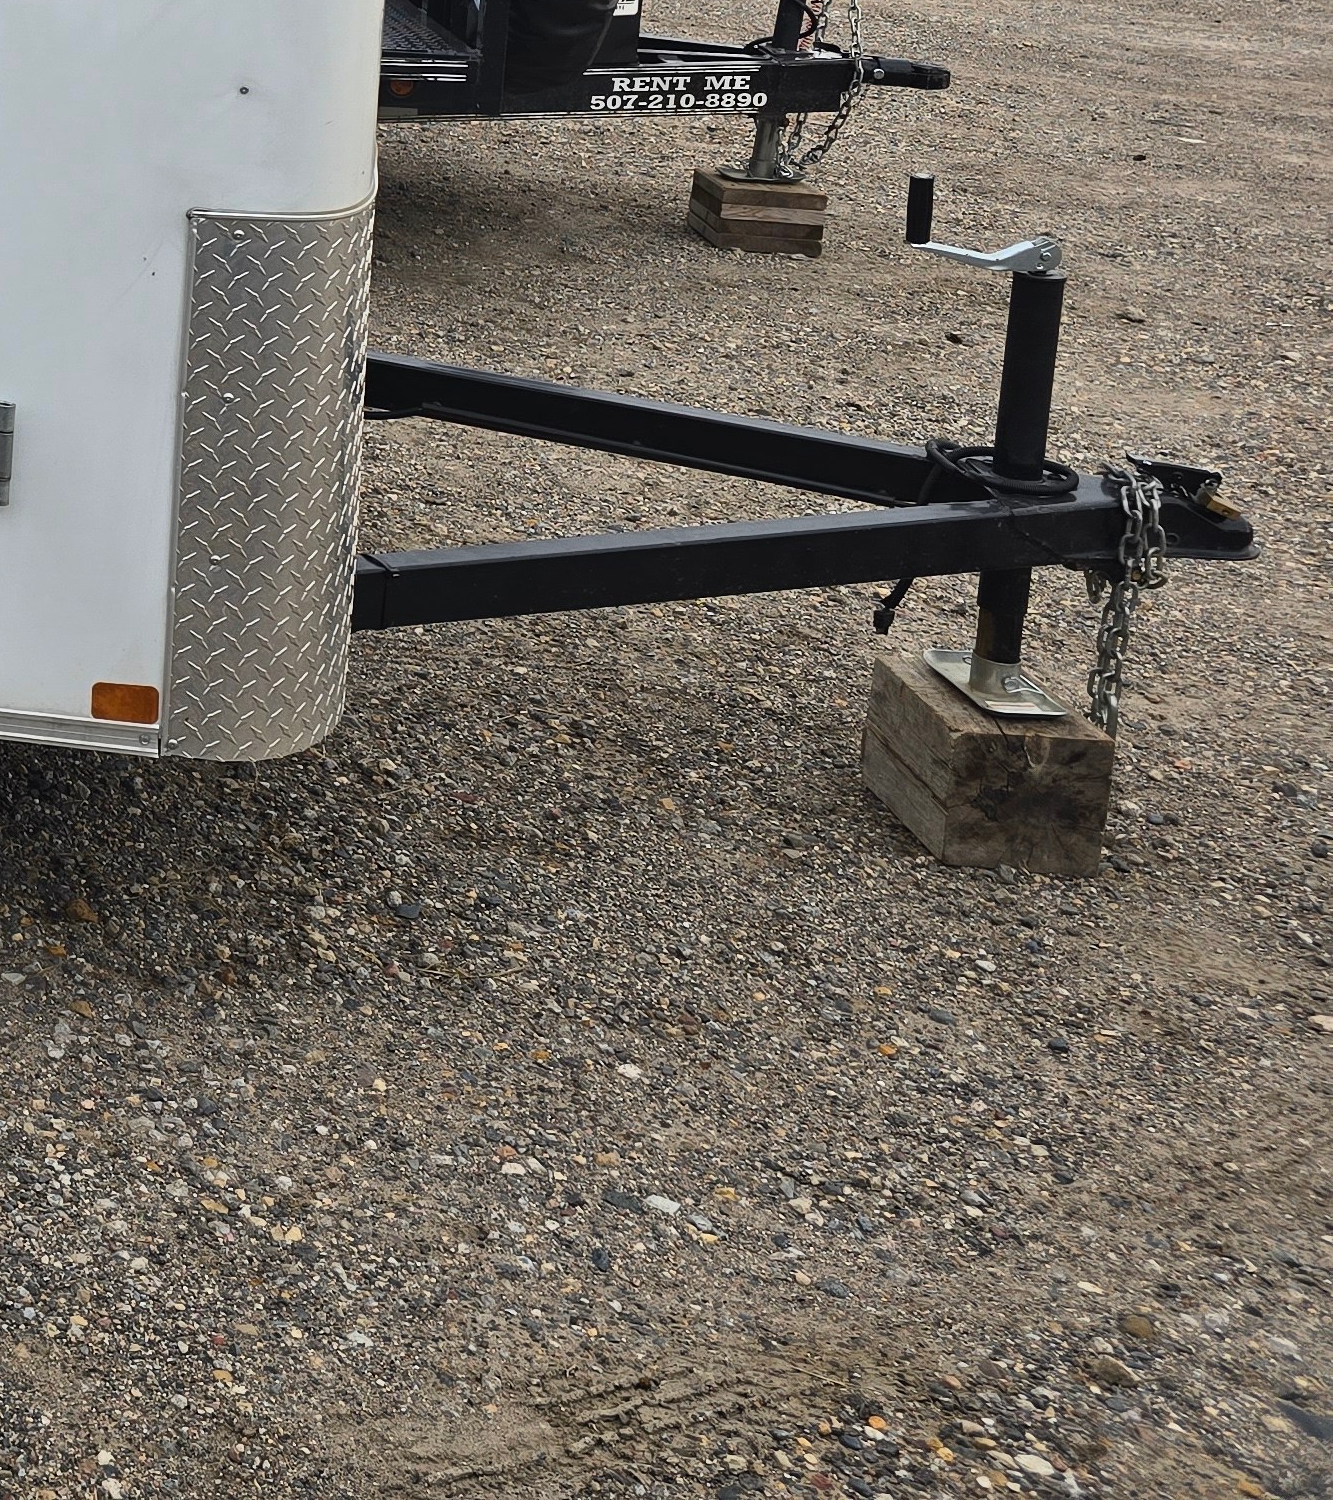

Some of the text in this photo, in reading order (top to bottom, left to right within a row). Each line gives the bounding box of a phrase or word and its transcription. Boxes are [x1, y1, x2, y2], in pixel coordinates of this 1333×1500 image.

[611, 75, 751, 92] RENT ME
[590, 92, 768, 110] 507-210-8890
